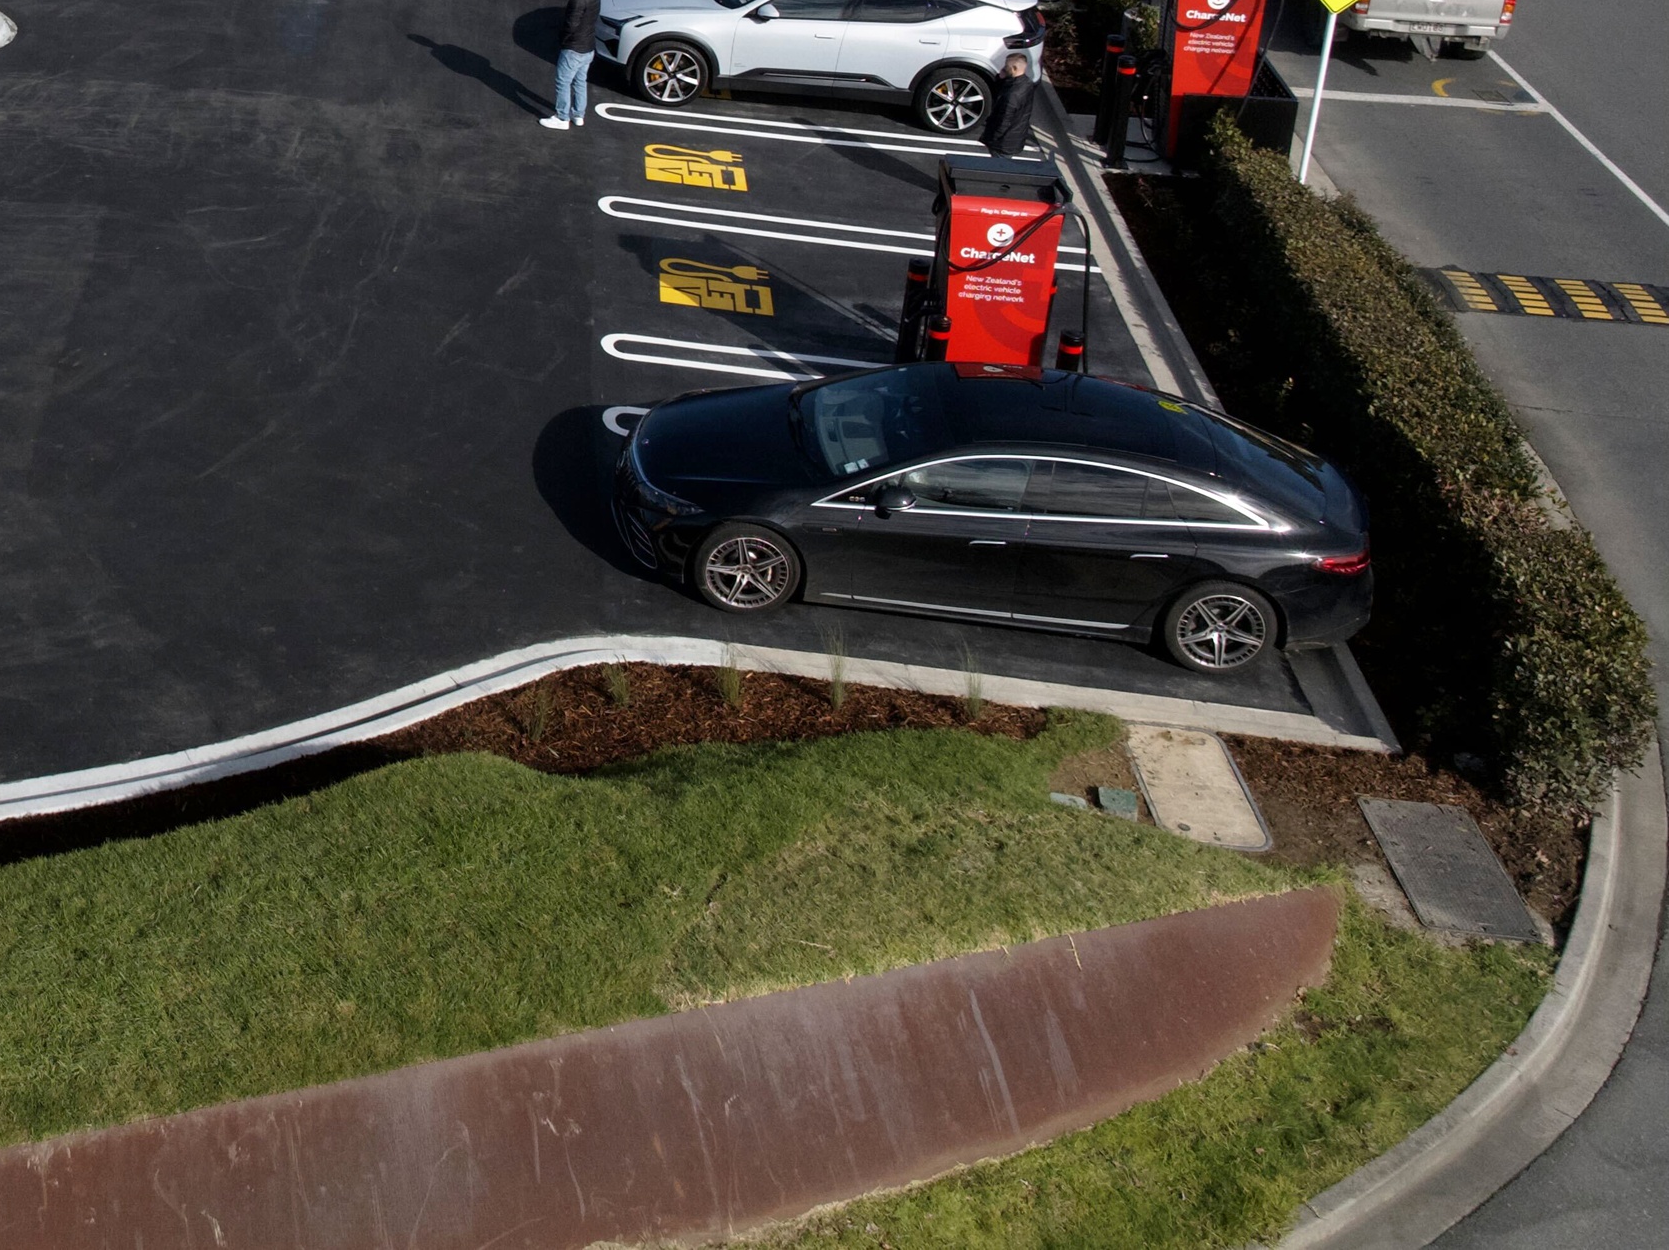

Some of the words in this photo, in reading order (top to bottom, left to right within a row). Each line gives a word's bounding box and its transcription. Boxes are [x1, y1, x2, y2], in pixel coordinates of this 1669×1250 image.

[1190, 32, 1204, 40] New
[1206, 32, 1234, 41] Zealand's
[1188, 38, 1211, 46] electric
[1212, 40, 1234, 48] vehicle
[1184, 45, 1208, 54] charging
[966, 275, 984, 284] New
[985, 276, 1021, 286] Zealand's
[964, 283, 992, 292] electric
[994, 286, 1021, 294] vehicle
[958, 291, 991, 301] charging
[993, 294, 1024, 303] network
